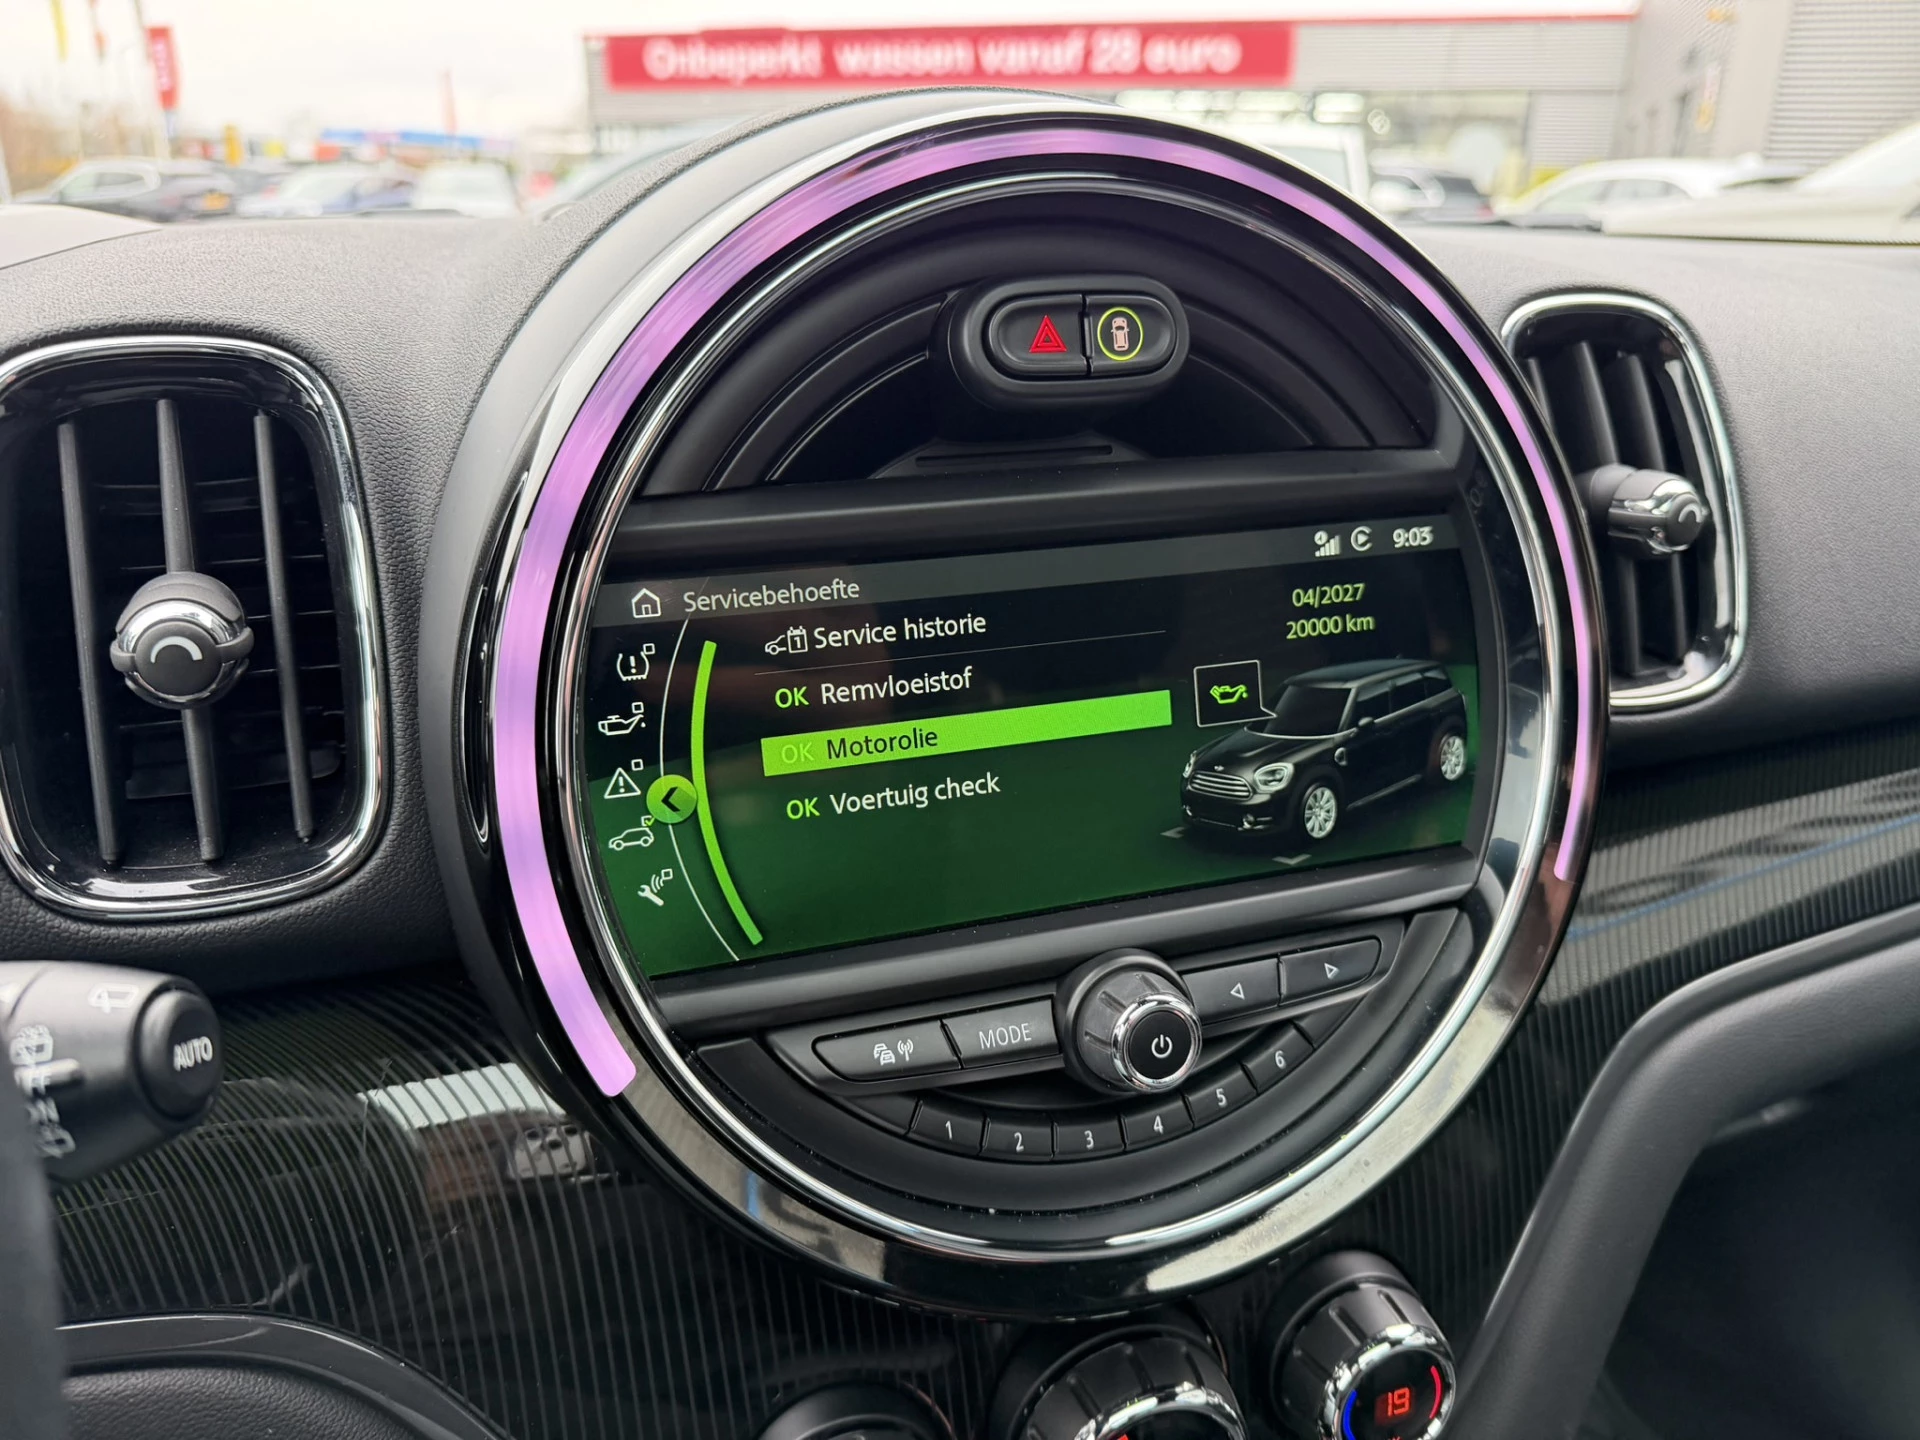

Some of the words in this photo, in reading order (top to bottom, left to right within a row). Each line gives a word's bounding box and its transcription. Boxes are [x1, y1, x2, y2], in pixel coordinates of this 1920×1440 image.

[833, 37, 975, 78] wassen
[977, 27, 1088, 76] vanaf
[1143, 34, 1243, 75] euro
[1392, 525, 1433, 548] 9:03
[683, 579, 860, 613] Servicebehoefte
[1292, 582, 1366, 609] 04/2027
[813, 623, 897, 649] Service
[903, 613, 987, 641] historie
[1286, 615, 1343, 639] 20000
[1345, 613, 1376, 633] km
[774, 686, 810, 709] OK
[820, 665, 973, 705] Remvloeistof
[781, 741, 815, 764] OK
[826, 727, 938, 760] Motorolie
[786, 796, 821, 820] OK
[829, 783, 929, 815] Voertuig
[934, 771, 1001, 801] check
[978, 1022, 1032, 1050] MODE
[173, 1035, 214, 1072] AUTO
[1274, 1049, 1287, 1070] 6
[1215, 1087, 1228, 1108] 5
[944, 1120, 953, 1140] 1
[1153, 1114, 1164, 1135] 4
[1013, 1131, 1025, 1153] 2
[1083, 1129, 1095, 1150] 3
[1387, 1386, 1410, 1417] 19
